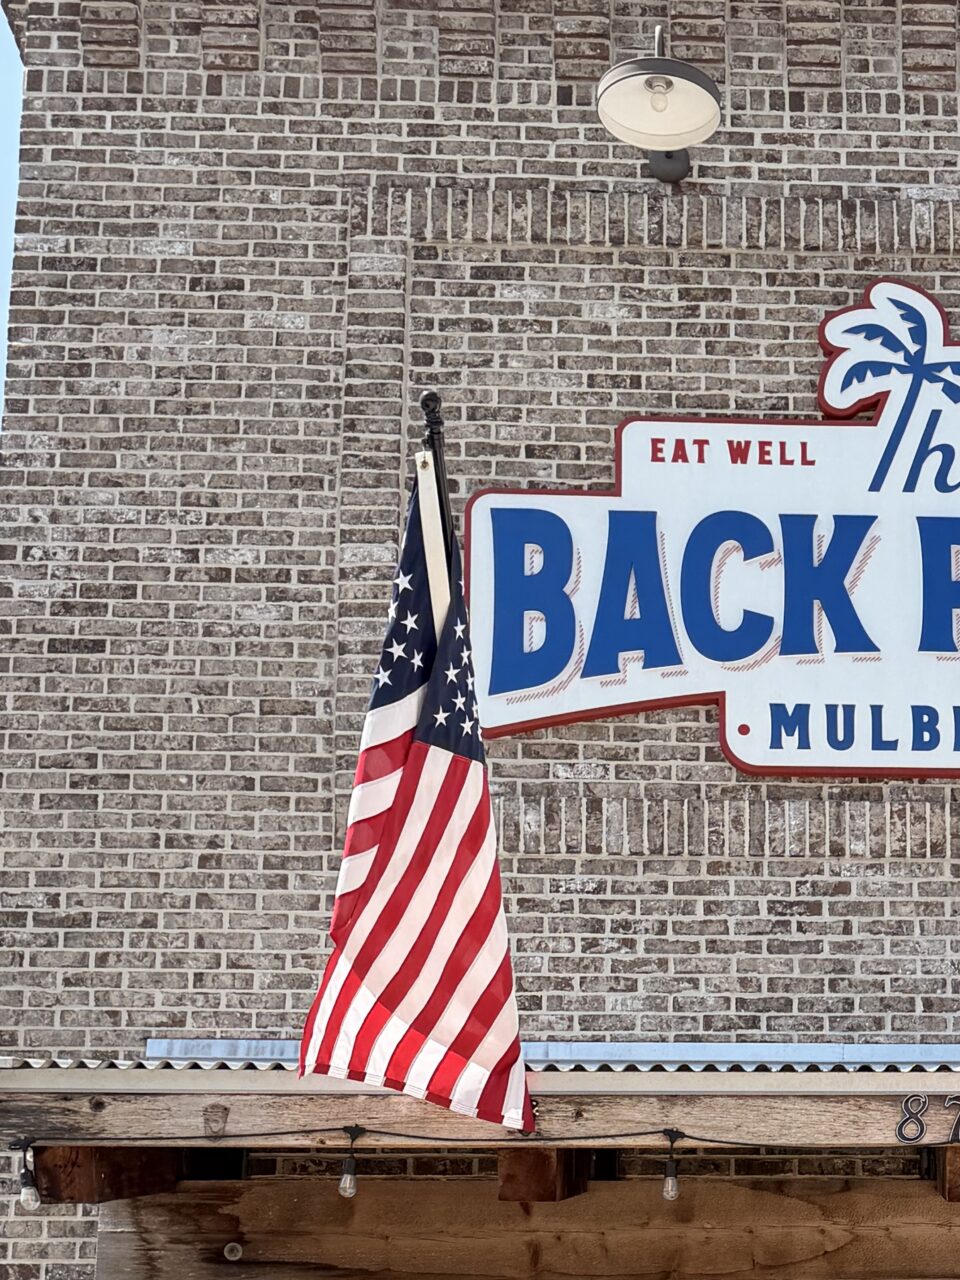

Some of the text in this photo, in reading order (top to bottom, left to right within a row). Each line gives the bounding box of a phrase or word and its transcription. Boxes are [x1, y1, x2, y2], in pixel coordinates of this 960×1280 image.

[650, 438, 817, 466] EAT WELL
[487, 507, 882, 696] BACK
